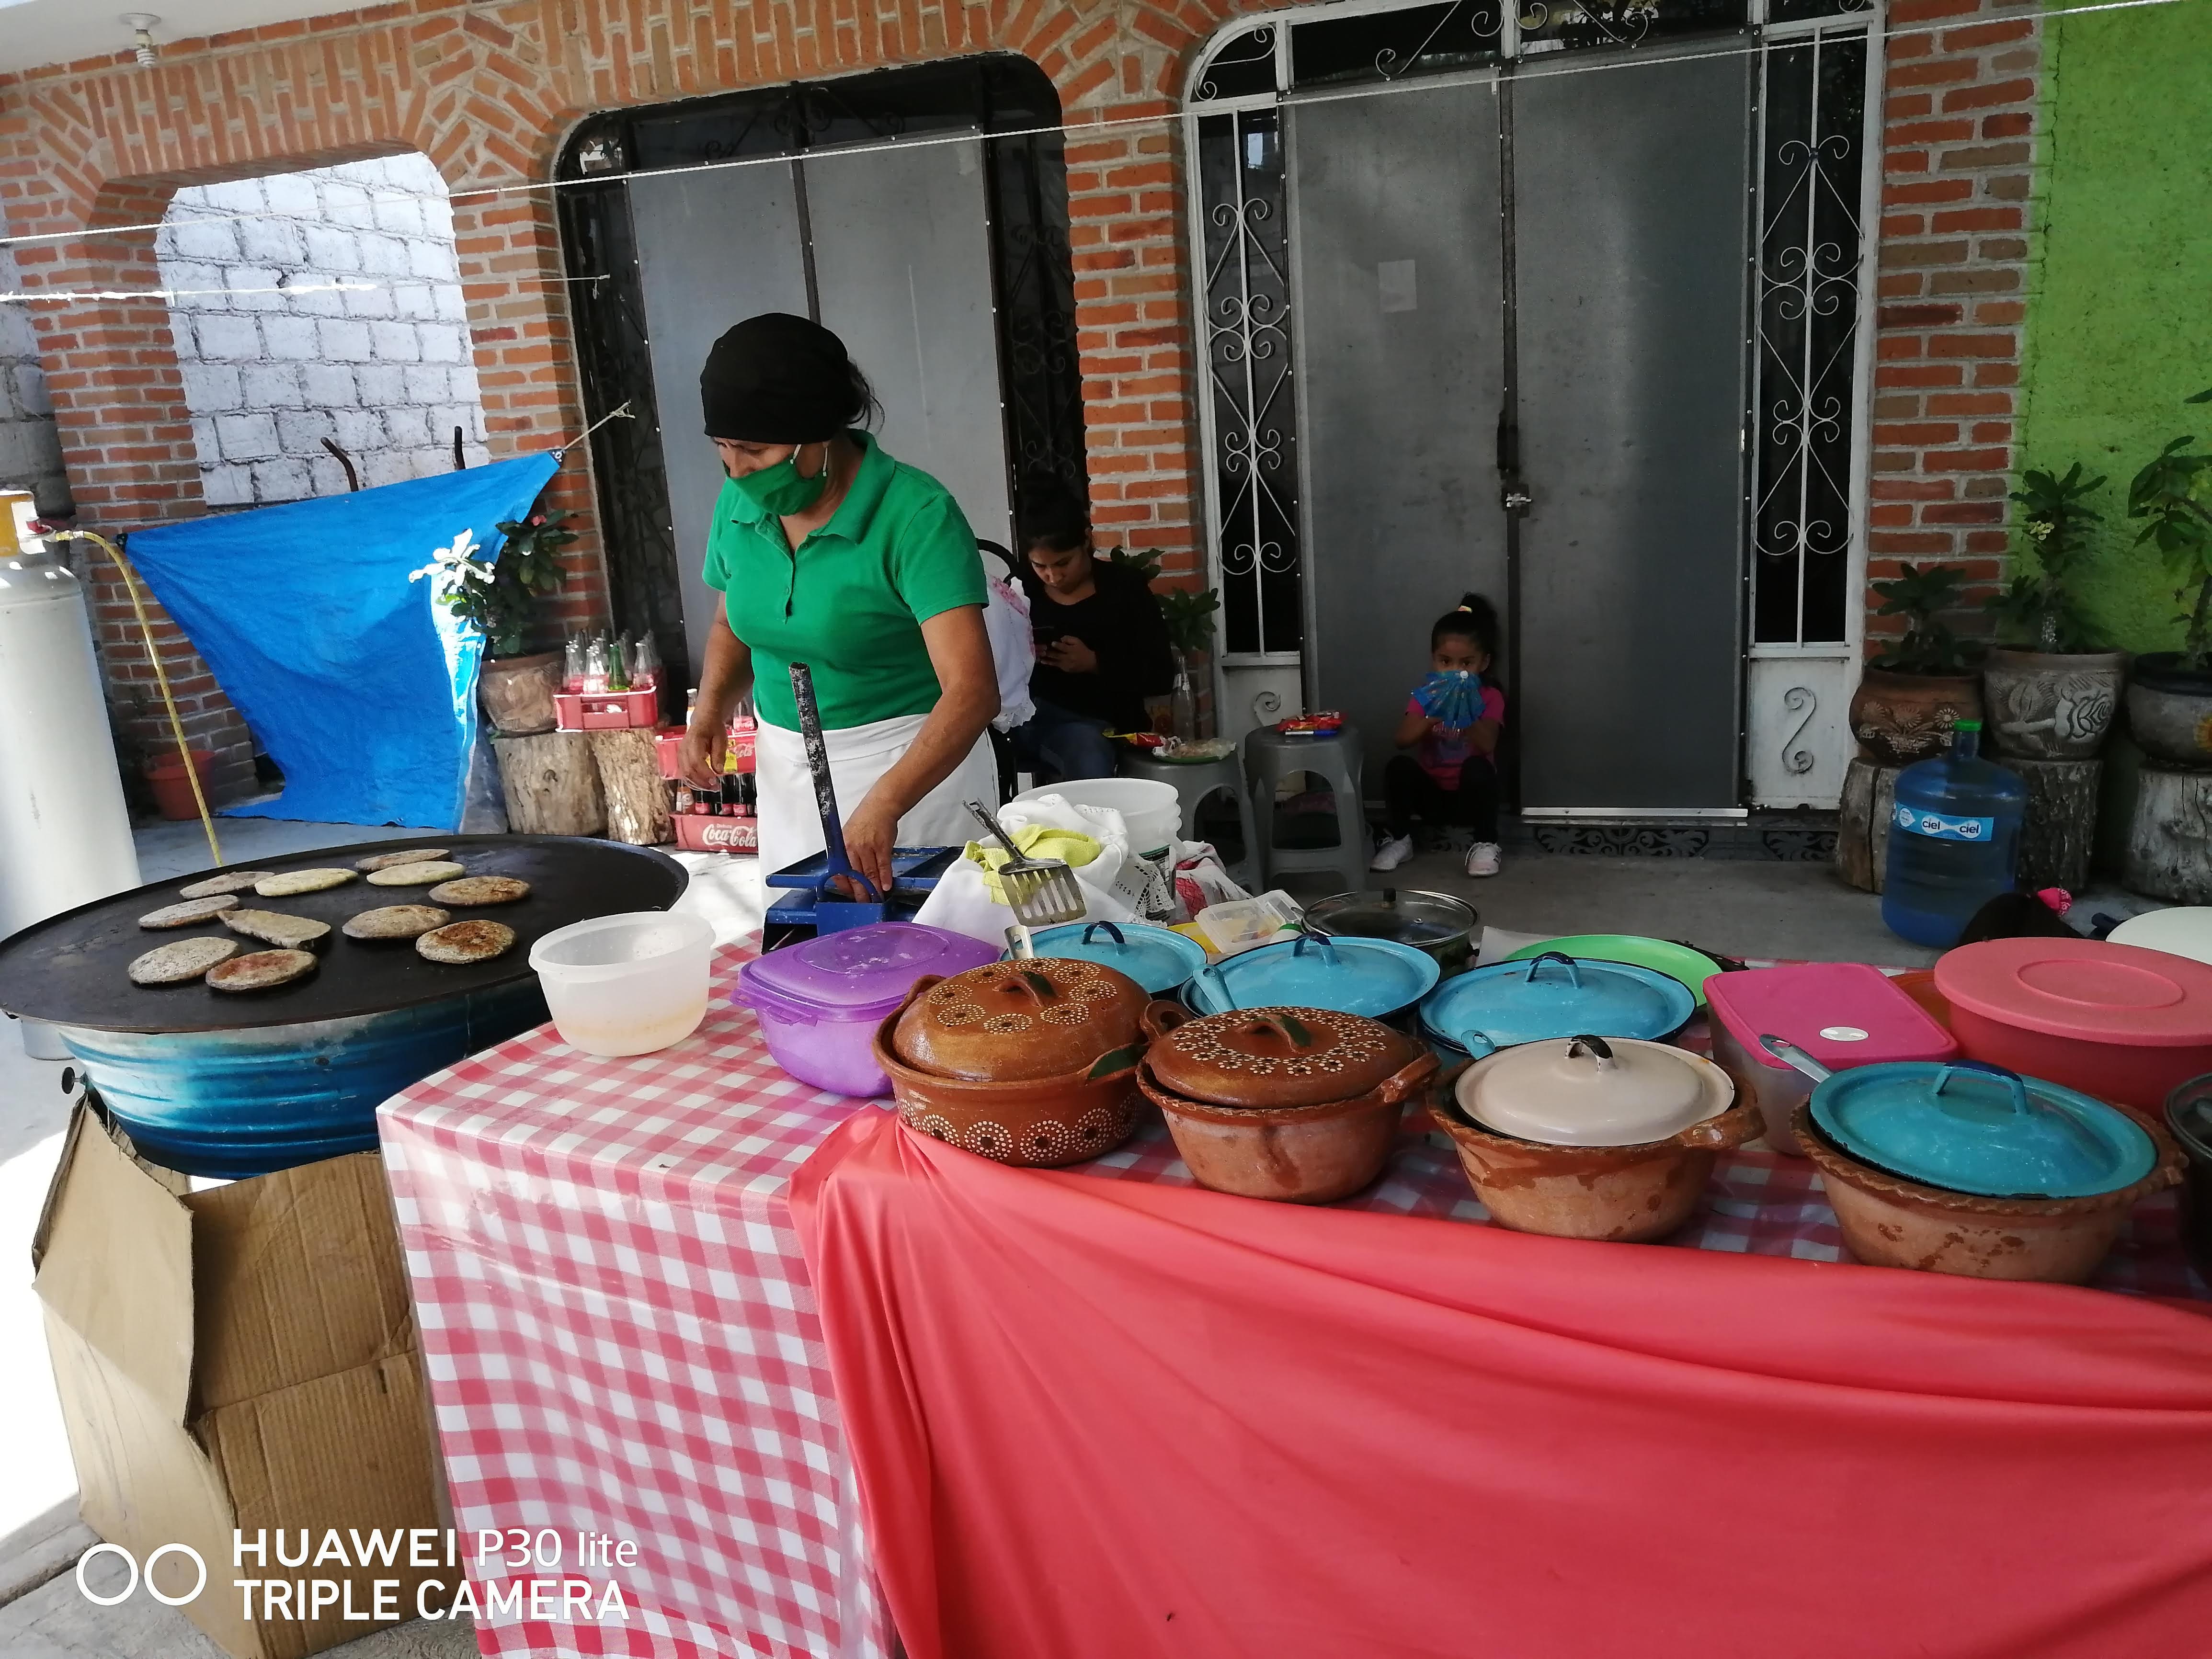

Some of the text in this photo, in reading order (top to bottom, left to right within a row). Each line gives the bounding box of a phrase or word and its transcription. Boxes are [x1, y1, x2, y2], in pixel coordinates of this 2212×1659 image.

[1922, 818, 1940, 830] ciel
[1960, 823, 1979, 834] ciel
[702, 824, 757, 847] Coca-Cola
